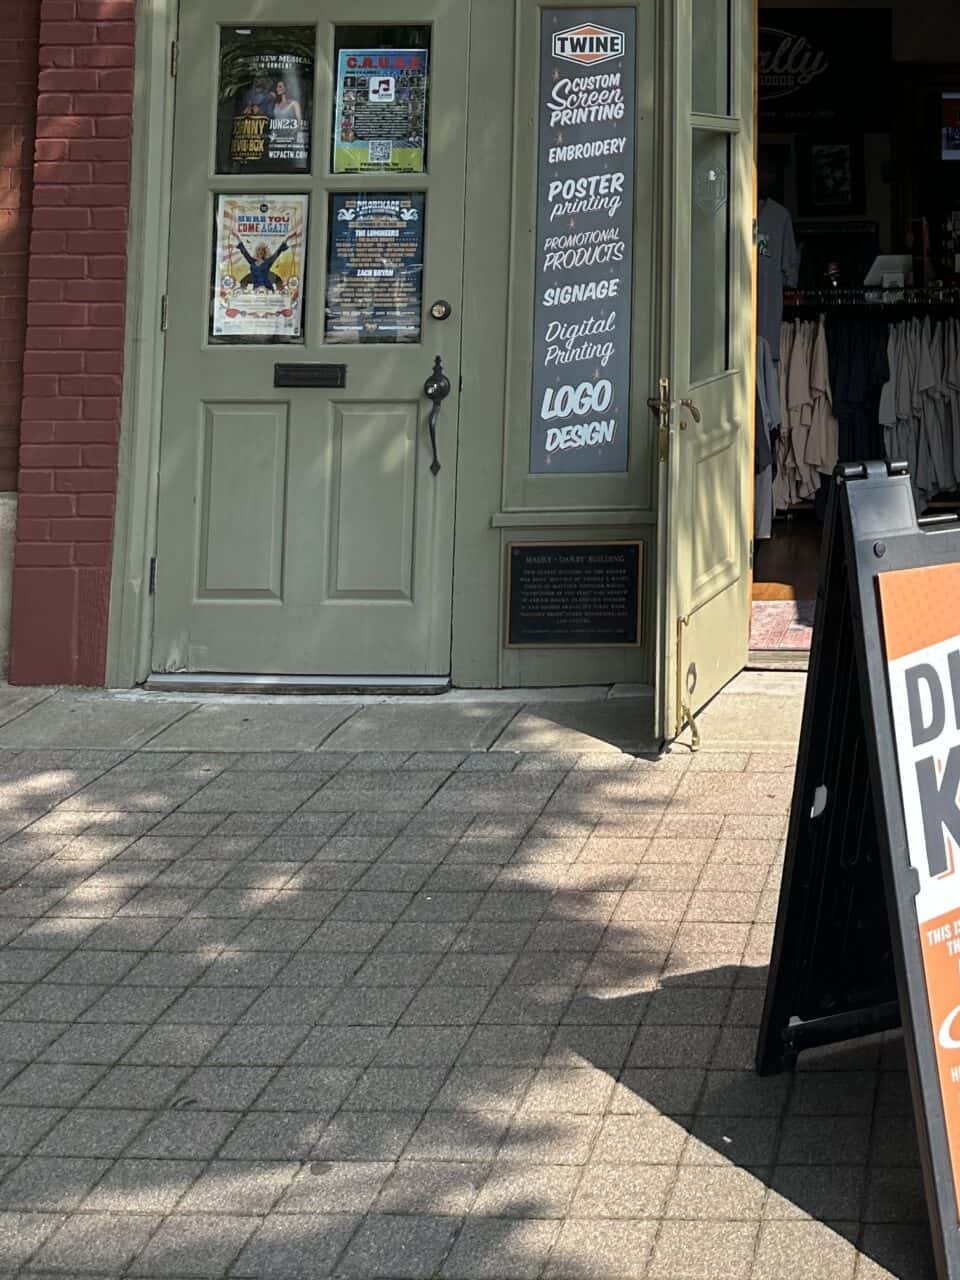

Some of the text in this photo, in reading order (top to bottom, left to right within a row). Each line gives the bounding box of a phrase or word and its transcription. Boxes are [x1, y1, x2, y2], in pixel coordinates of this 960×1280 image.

[557, 36, 620, 53] TWINE
[546, 78, 624, 111] Screen
[572, 73, 621, 92] CUSTOM
[550, 102, 624, 127] PRINTING
[548, 137, 626, 163] EMBROIDERY
[548, 172, 625, 202] POSTER
[550, 194, 622, 222] printing
[544, 227, 619, 251] PROMOTIONAL
[543, 241, 625, 272] PRODUCTS
[542, 278, 619, 306] SIGNAGE
[545, 311, 616, 349] Digital
[545, 340, 615, 367] Printing
[541, 379, 614, 420] LOGO
[545, 420, 615, 451] DESIGN
[927, 927, 951, 947] THIS
